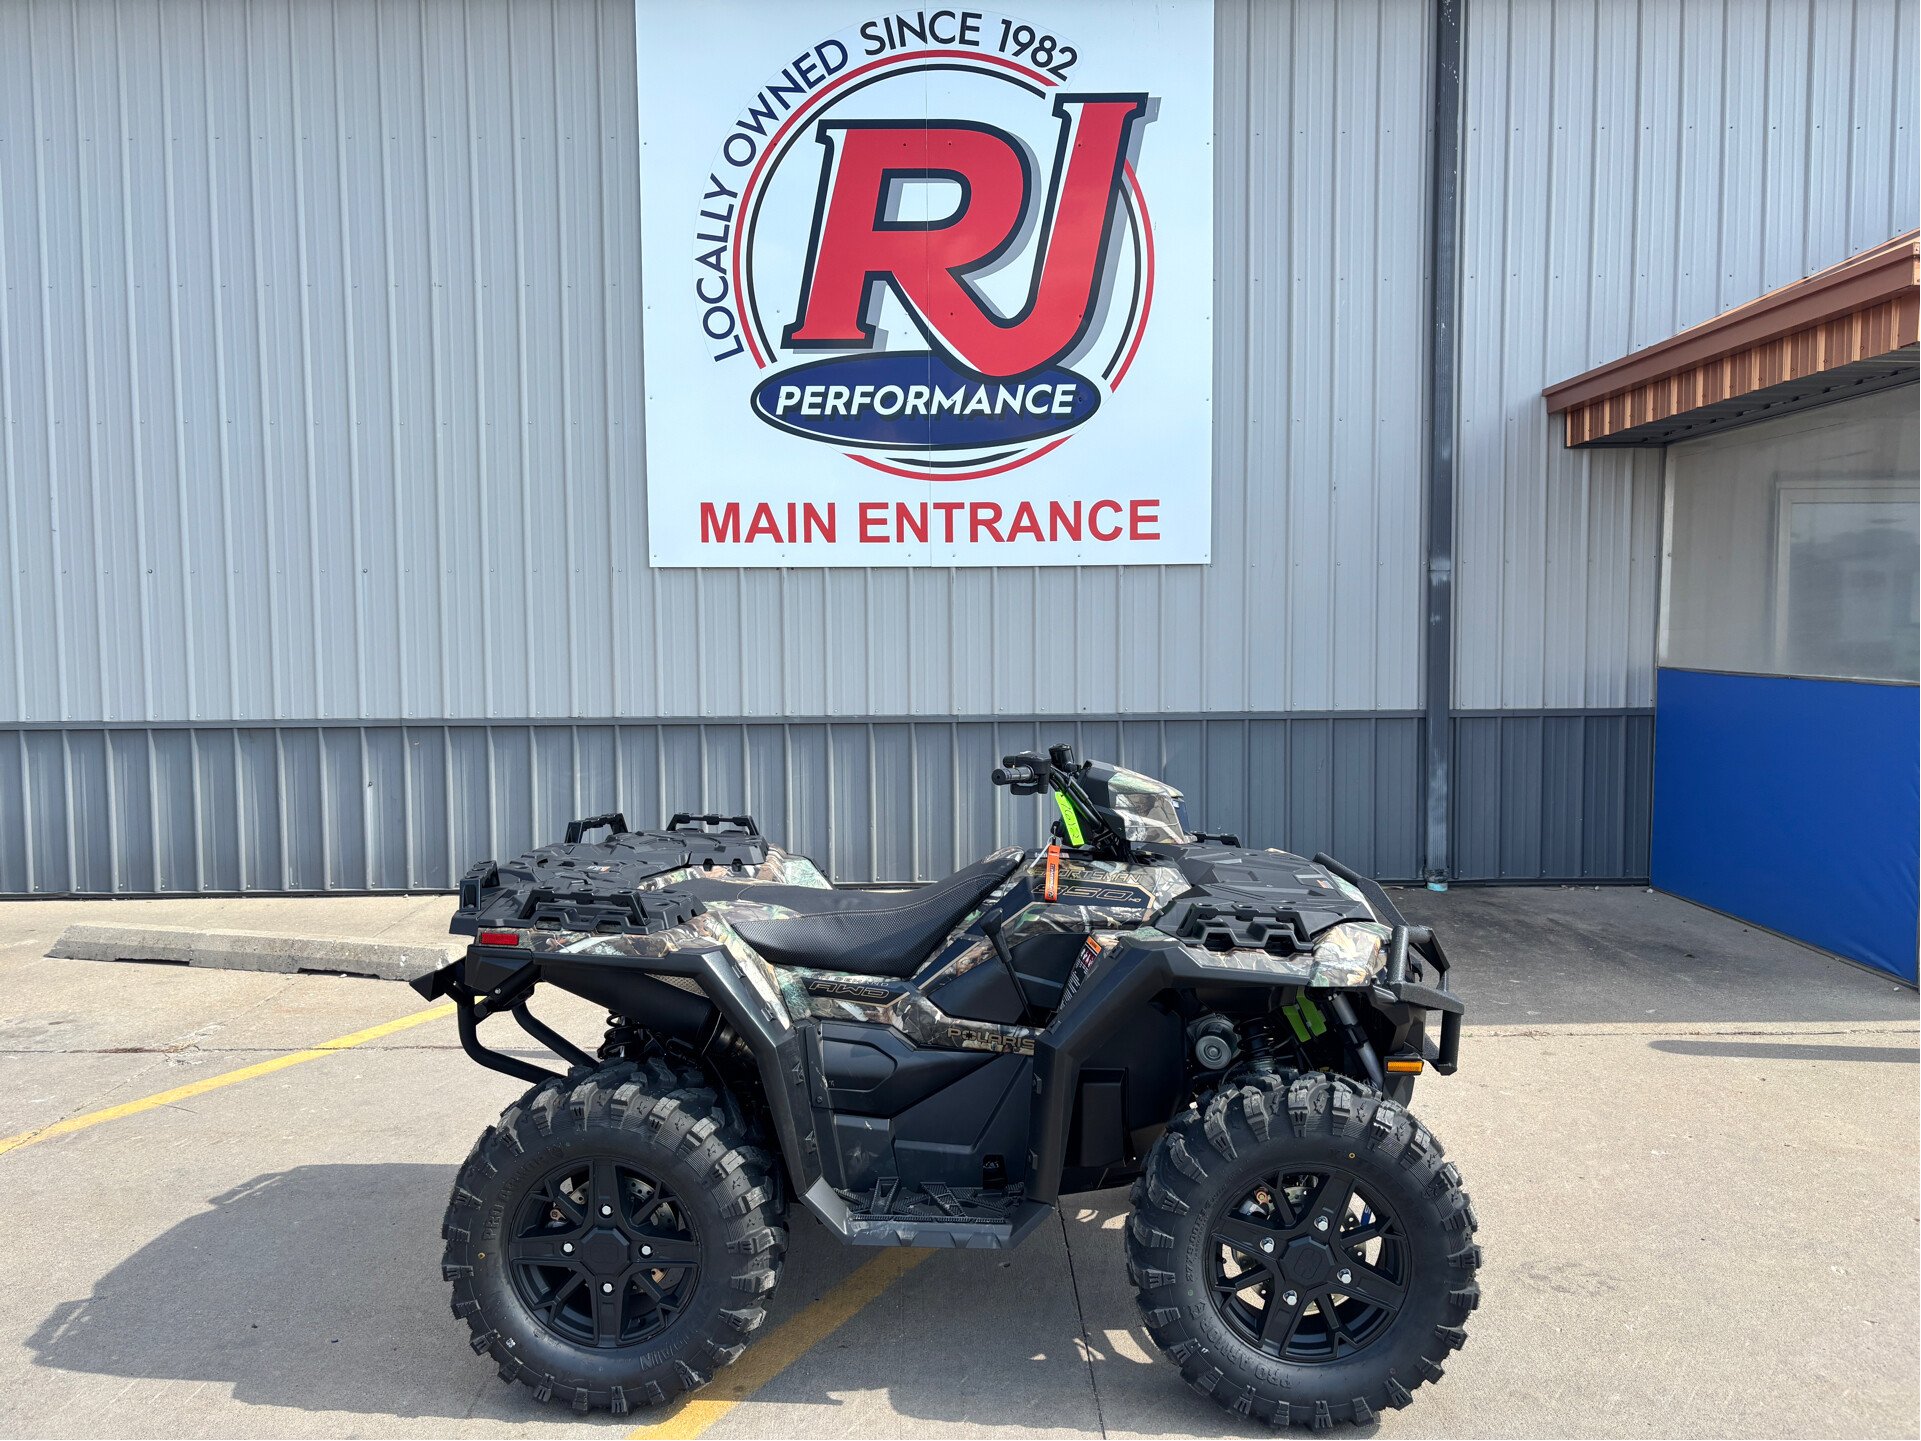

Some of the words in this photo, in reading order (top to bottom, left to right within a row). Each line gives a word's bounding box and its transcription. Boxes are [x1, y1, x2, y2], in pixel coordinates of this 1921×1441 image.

[695, 173, 745, 363] LOCALLY
[724, 39, 849, 167] OWNED
[860, 10, 983, 56] SINCE
[998, 18, 1078, 82] 1982
[780, 92, 1150, 383] RJ
[775, 384, 1077, 416] PERFORMANCE
[701, 502, 837, 544] MAIN
[858, 499, 1161, 544] ENTRANCE
[1033, 865, 1142, 883] SORTSMAN
[808, 980, 890, 999] AWD
[947, 1027, 1036, 1050] POLARIS
